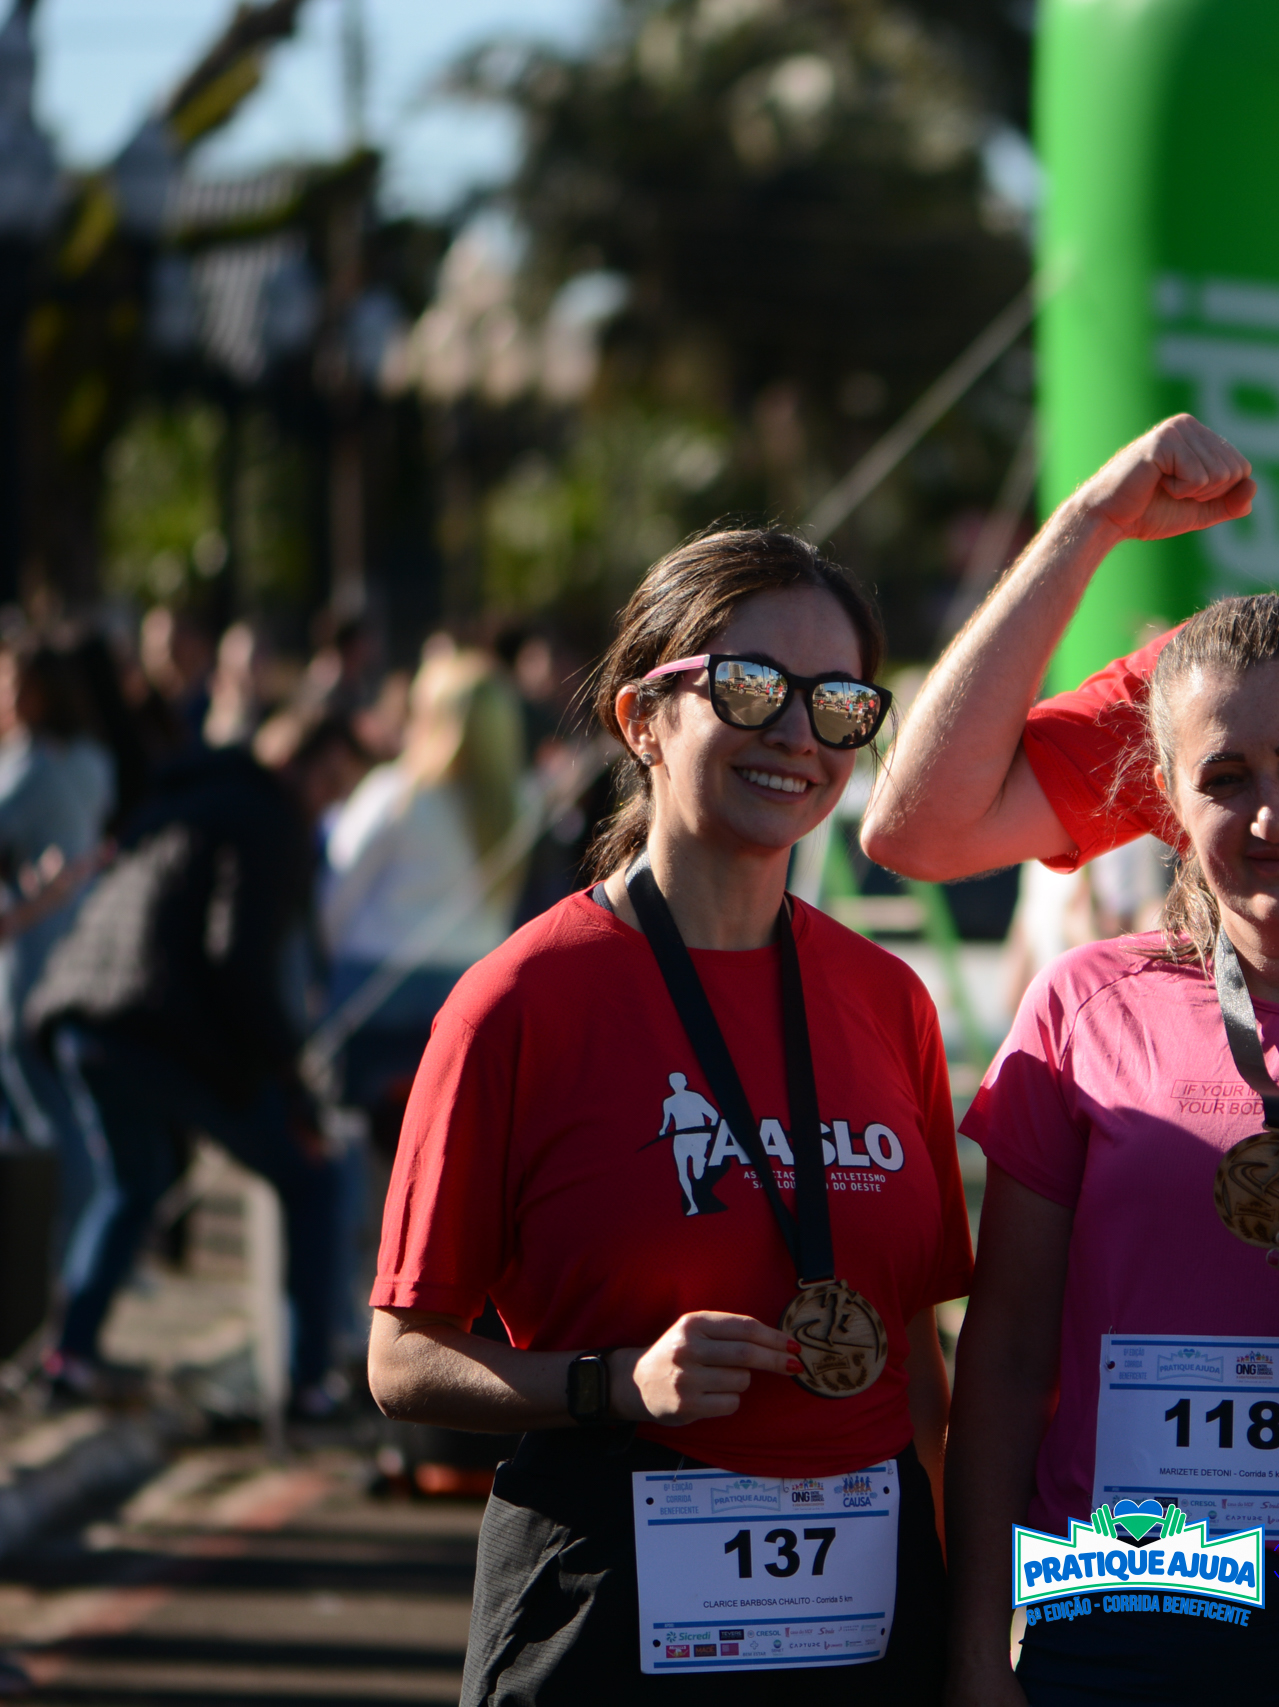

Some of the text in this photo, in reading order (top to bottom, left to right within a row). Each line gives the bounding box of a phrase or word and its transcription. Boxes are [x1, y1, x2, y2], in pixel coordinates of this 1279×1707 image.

[1183, 1084, 1198, 1096] IF
[1202, 1085, 1244, 1097] YOUR
[1179, 1100, 1226, 1114] YOUR
[1229, 1103, 1264, 1115] BOD
[831, 1172, 886, 1183] ATLETISMO
[833, 1182, 847, 1191] DO
[851, 1182, 882, 1192] OESTE
[1159, 1363, 1221, 1374] PRATIQUE AJUDA
[1236, 1363, 1257, 1375] ONG
[1159, 1467, 1198, 1476] MARIZETE
[1201, 1468, 1232, 1477] DETONI
[1239, 1469, 1266, 1478] Corrida
[671, 1481, 693, 1492] EDIÇÃO
[666, 1495, 692, 1504] CORRIDA
[714, 1494, 778, 1506] PRATIQUE AJUDA
[792, 1491, 810, 1503] ONG
[843, 1496, 872, 1508] CAUSA
[660, 1506, 699, 1515] BENEFICENTE
[724, 1527, 836, 1579] 137
[703, 1599, 738, 1609] CLARICE
[740, 1598, 777, 1607] BARBOSA
[778, 1597, 811, 1606] CHALITO
[816, 1595, 838, 1604] Corrida
[839, 1595, 843, 1603] 5
[679, 1631, 711, 1641] Sicredi
